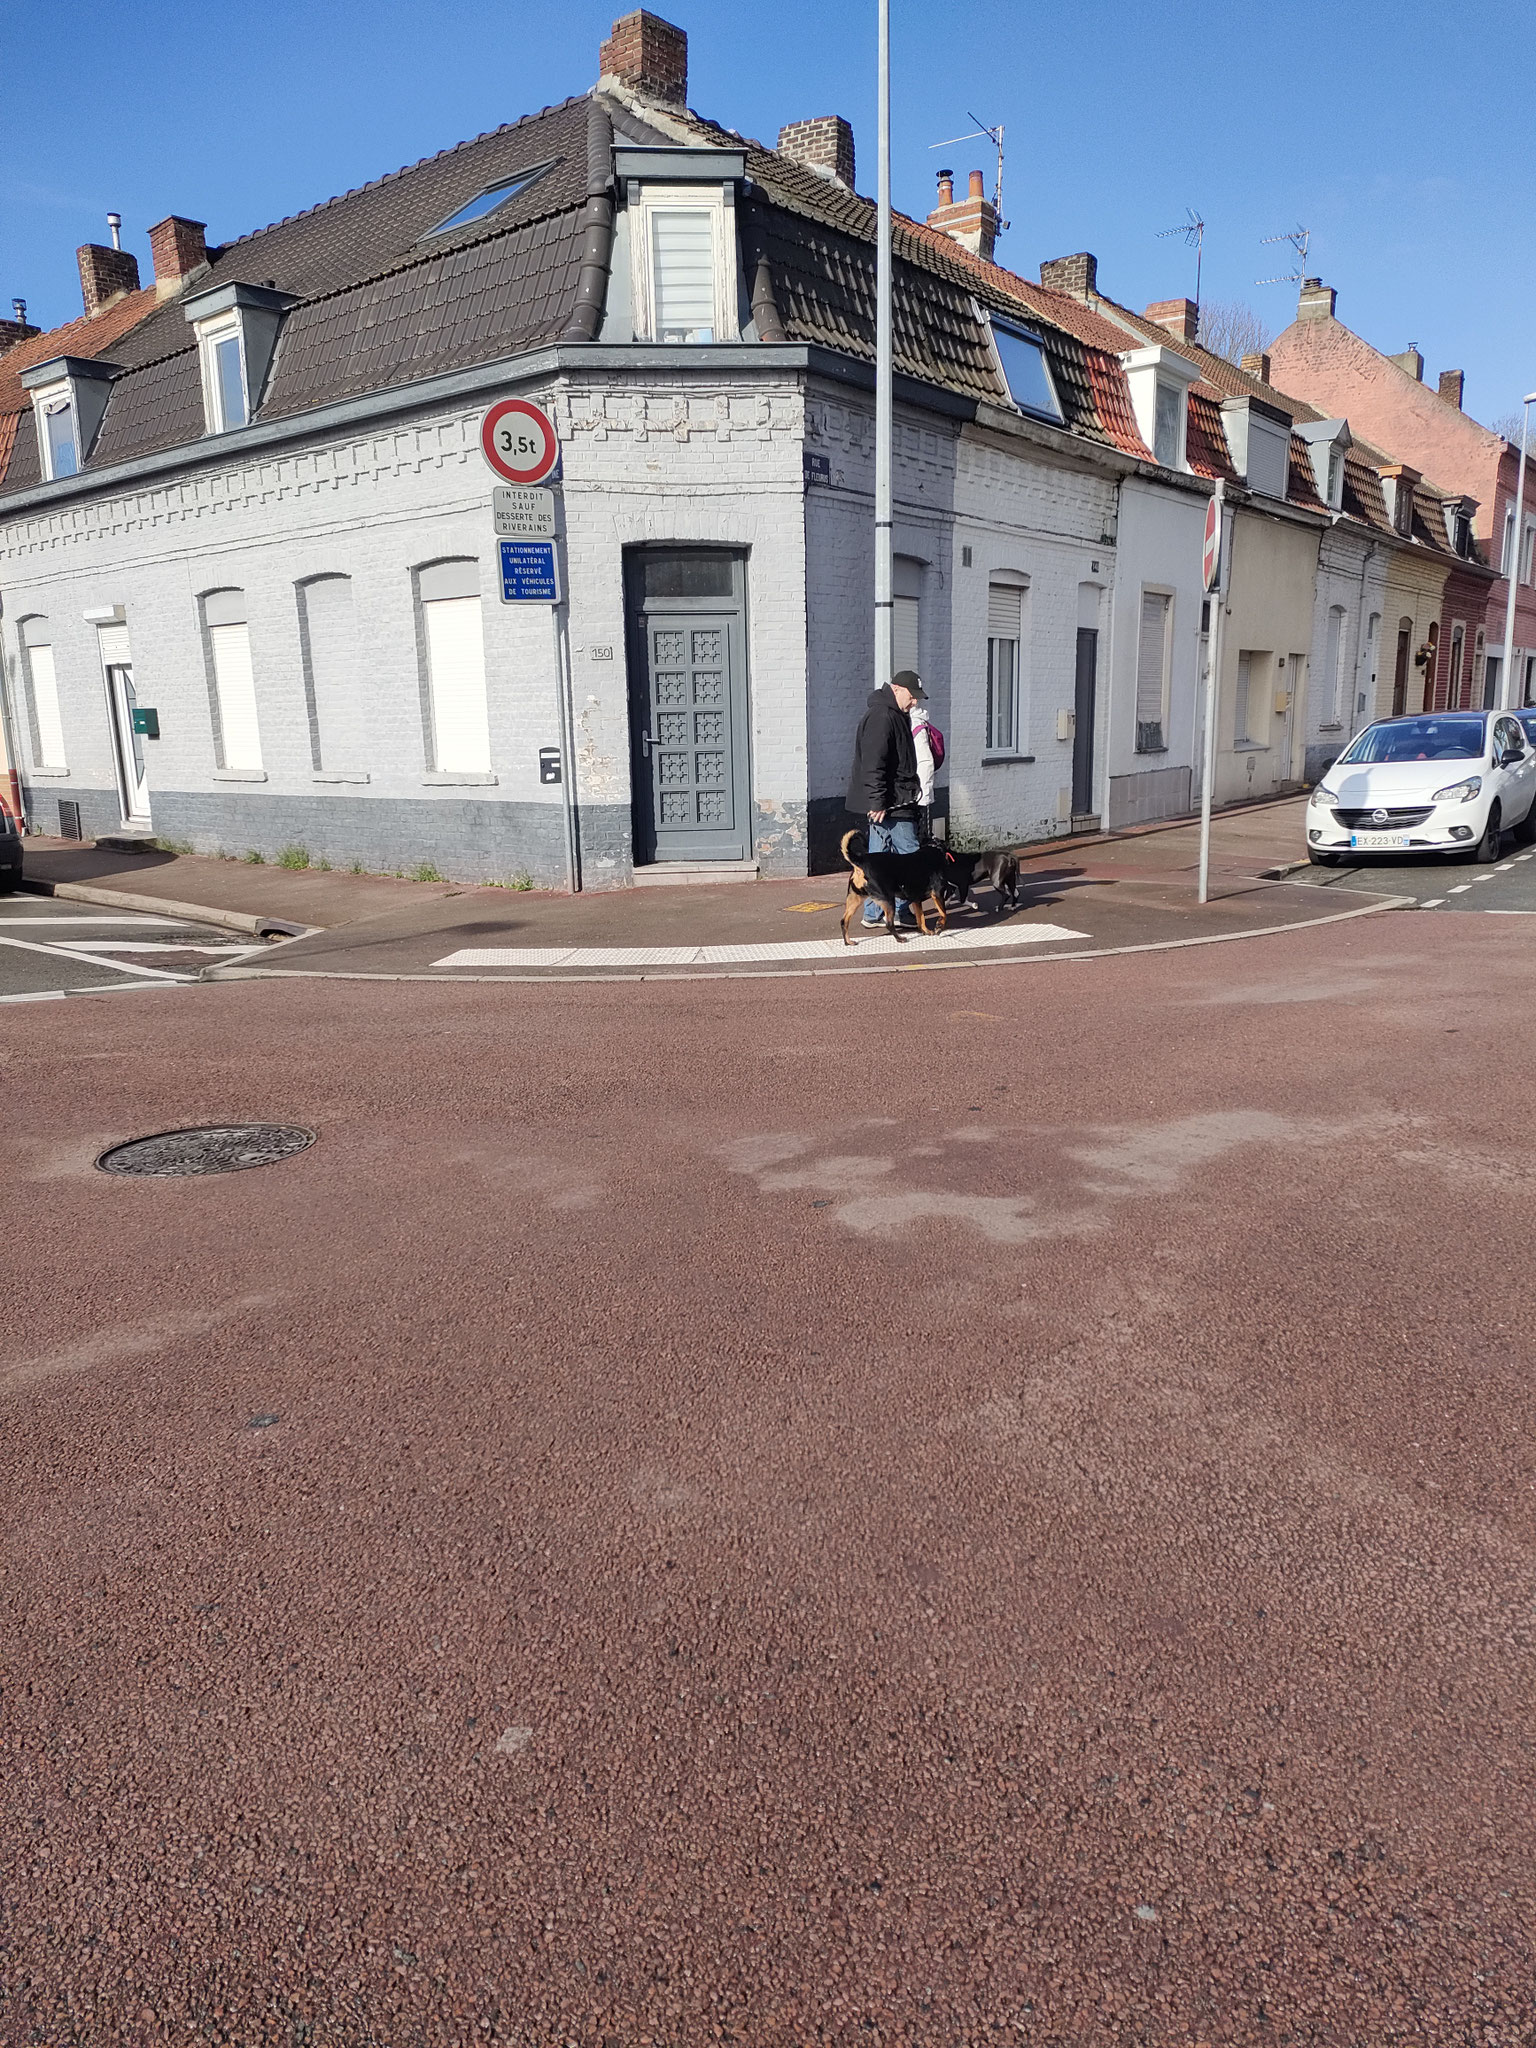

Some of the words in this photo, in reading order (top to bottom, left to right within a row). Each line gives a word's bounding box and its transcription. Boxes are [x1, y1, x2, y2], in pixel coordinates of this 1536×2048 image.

[501, 430, 536, 456] 3,5t
[811, 457, 821, 468] RUE
[502, 491, 543, 500] INTERDIT
[512, 502, 535, 510] SAUF
[496, 512, 533, 521] DESSERTE
[538, 514, 552, 522] DES
[502, 522, 547, 532] RIVERAINS
[502, 546, 551, 554] STATIONNEMENT
[509, 556, 546, 565] UNILATÉRAL
[514, 567, 542, 575] RÉSERVÉ
[521, 577, 554, 585] VÉHICULES
[591, 648, 611, 658] 150
[1357, 836, 1404, 846] EX-223-VD
